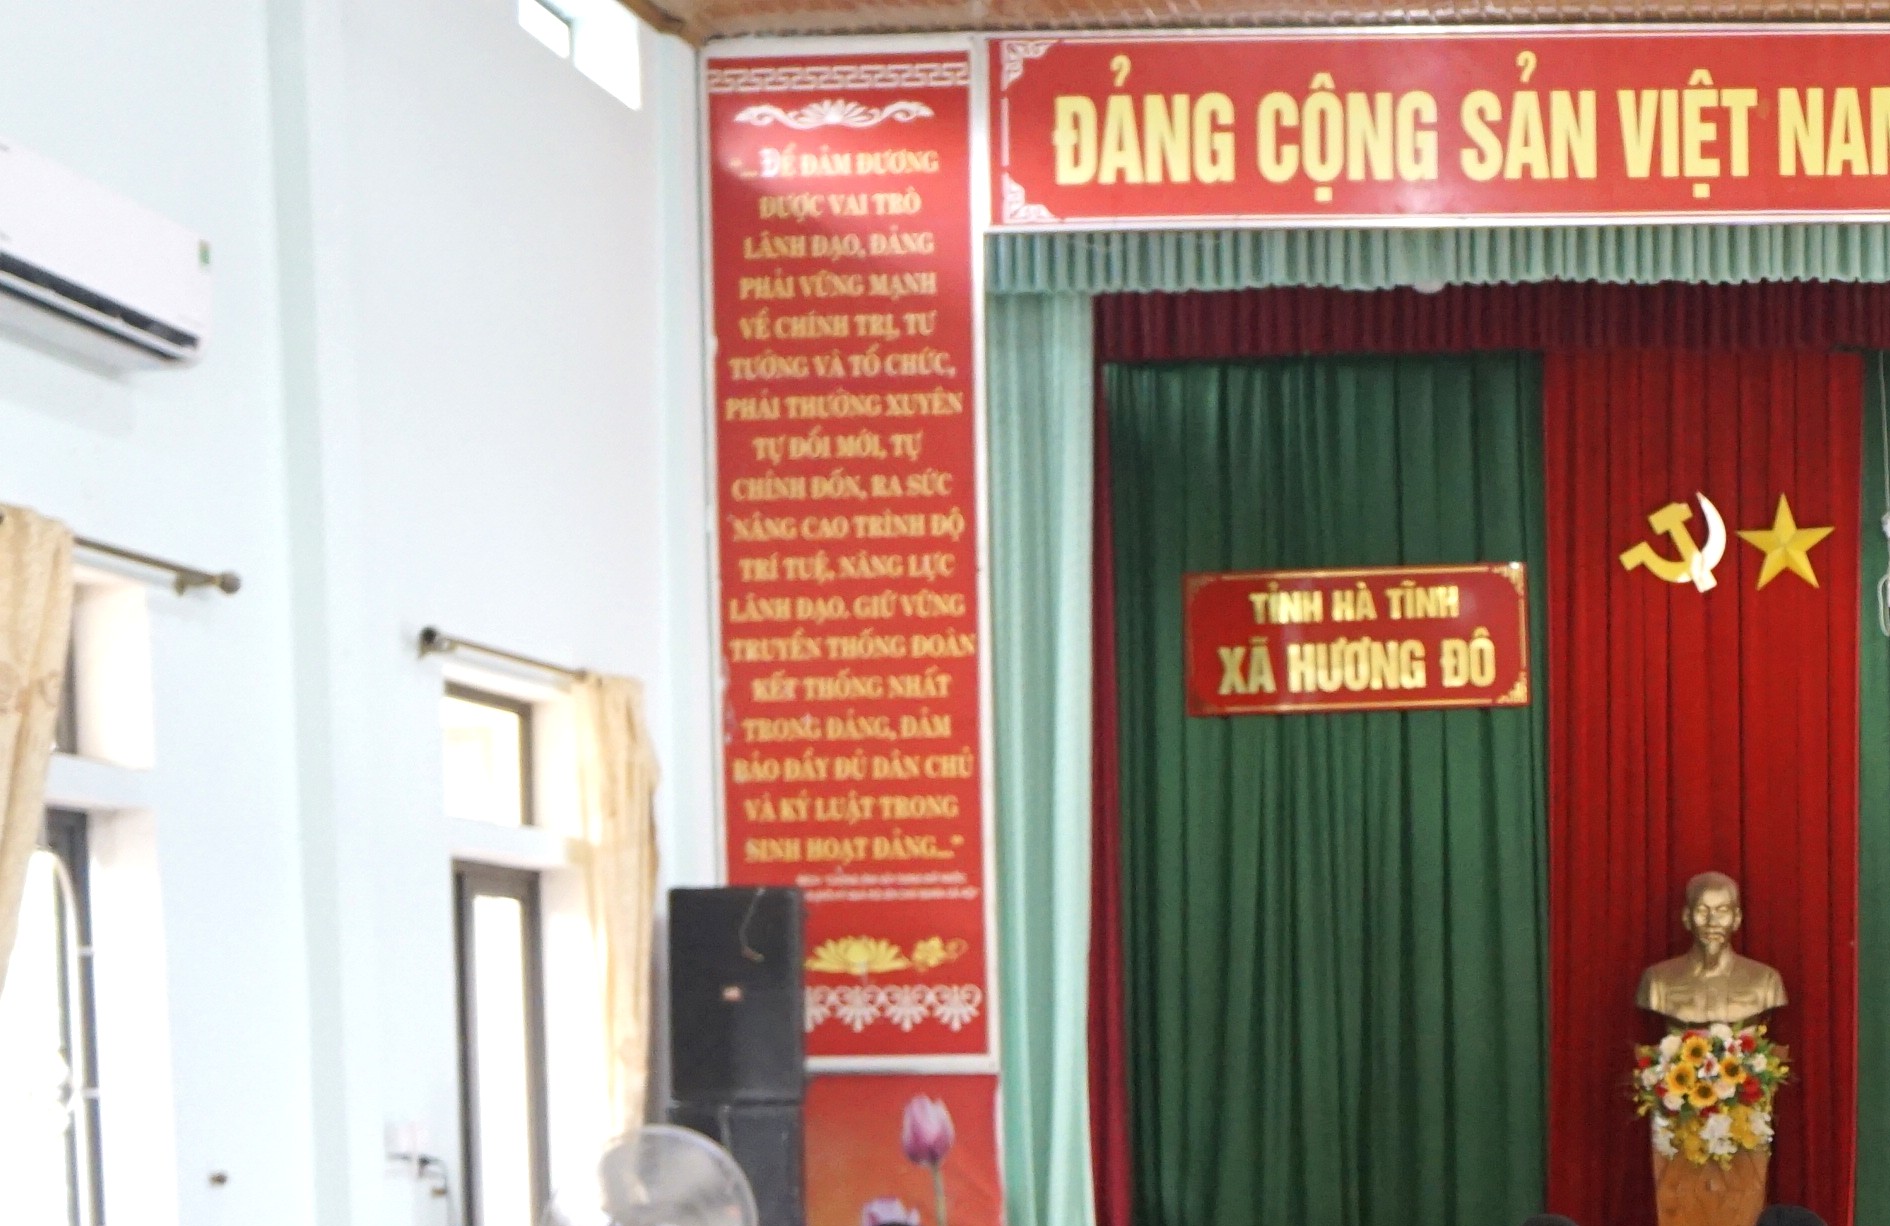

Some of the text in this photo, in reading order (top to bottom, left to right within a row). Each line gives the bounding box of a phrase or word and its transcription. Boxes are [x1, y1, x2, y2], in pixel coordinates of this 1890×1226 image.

[1052, 55, 1235, 185] ĐẢNG
[1257, 72, 1438, 202] CỘNG
[1460, 51, 1596, 182] SẢN
[1617, 69, 1758, 199] VIỆT
[828, 193, 868, 216] VAI
[870, 475, 903, 498] RA
[801, 516, 849, 541] CAO
[1249, 580, 1460, 625] TỈNH HÀ TĨNH
[1216, 635, 1277, 695] XÃ
[1287, 636, 1427, 694] HƯƠNG
[741, 717, 821, 743] TRONG
[879, 794, 960, 820] TRONG
[745, 839, 801, 863] SINH
